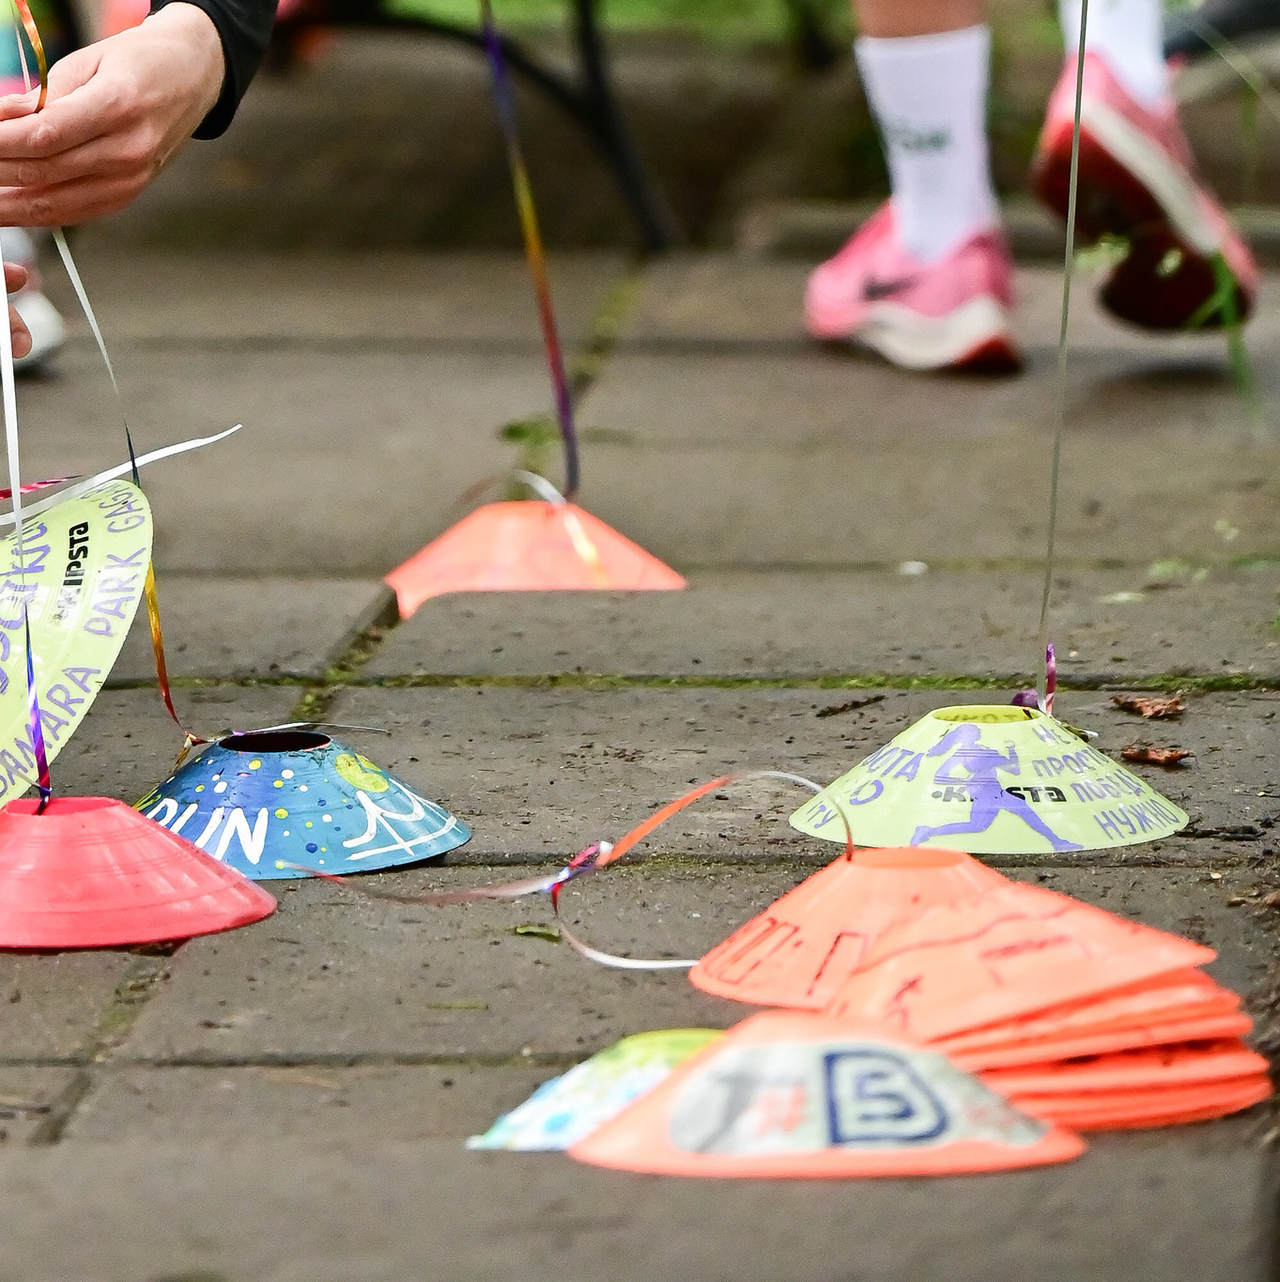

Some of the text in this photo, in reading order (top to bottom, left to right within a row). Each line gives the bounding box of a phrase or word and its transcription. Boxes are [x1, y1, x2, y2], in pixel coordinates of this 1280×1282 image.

[84, 546, 148, 638] PARK
[942, 786, 1067, 803] KSTA
[1093, 798, 1181, 841] НУЖНО
